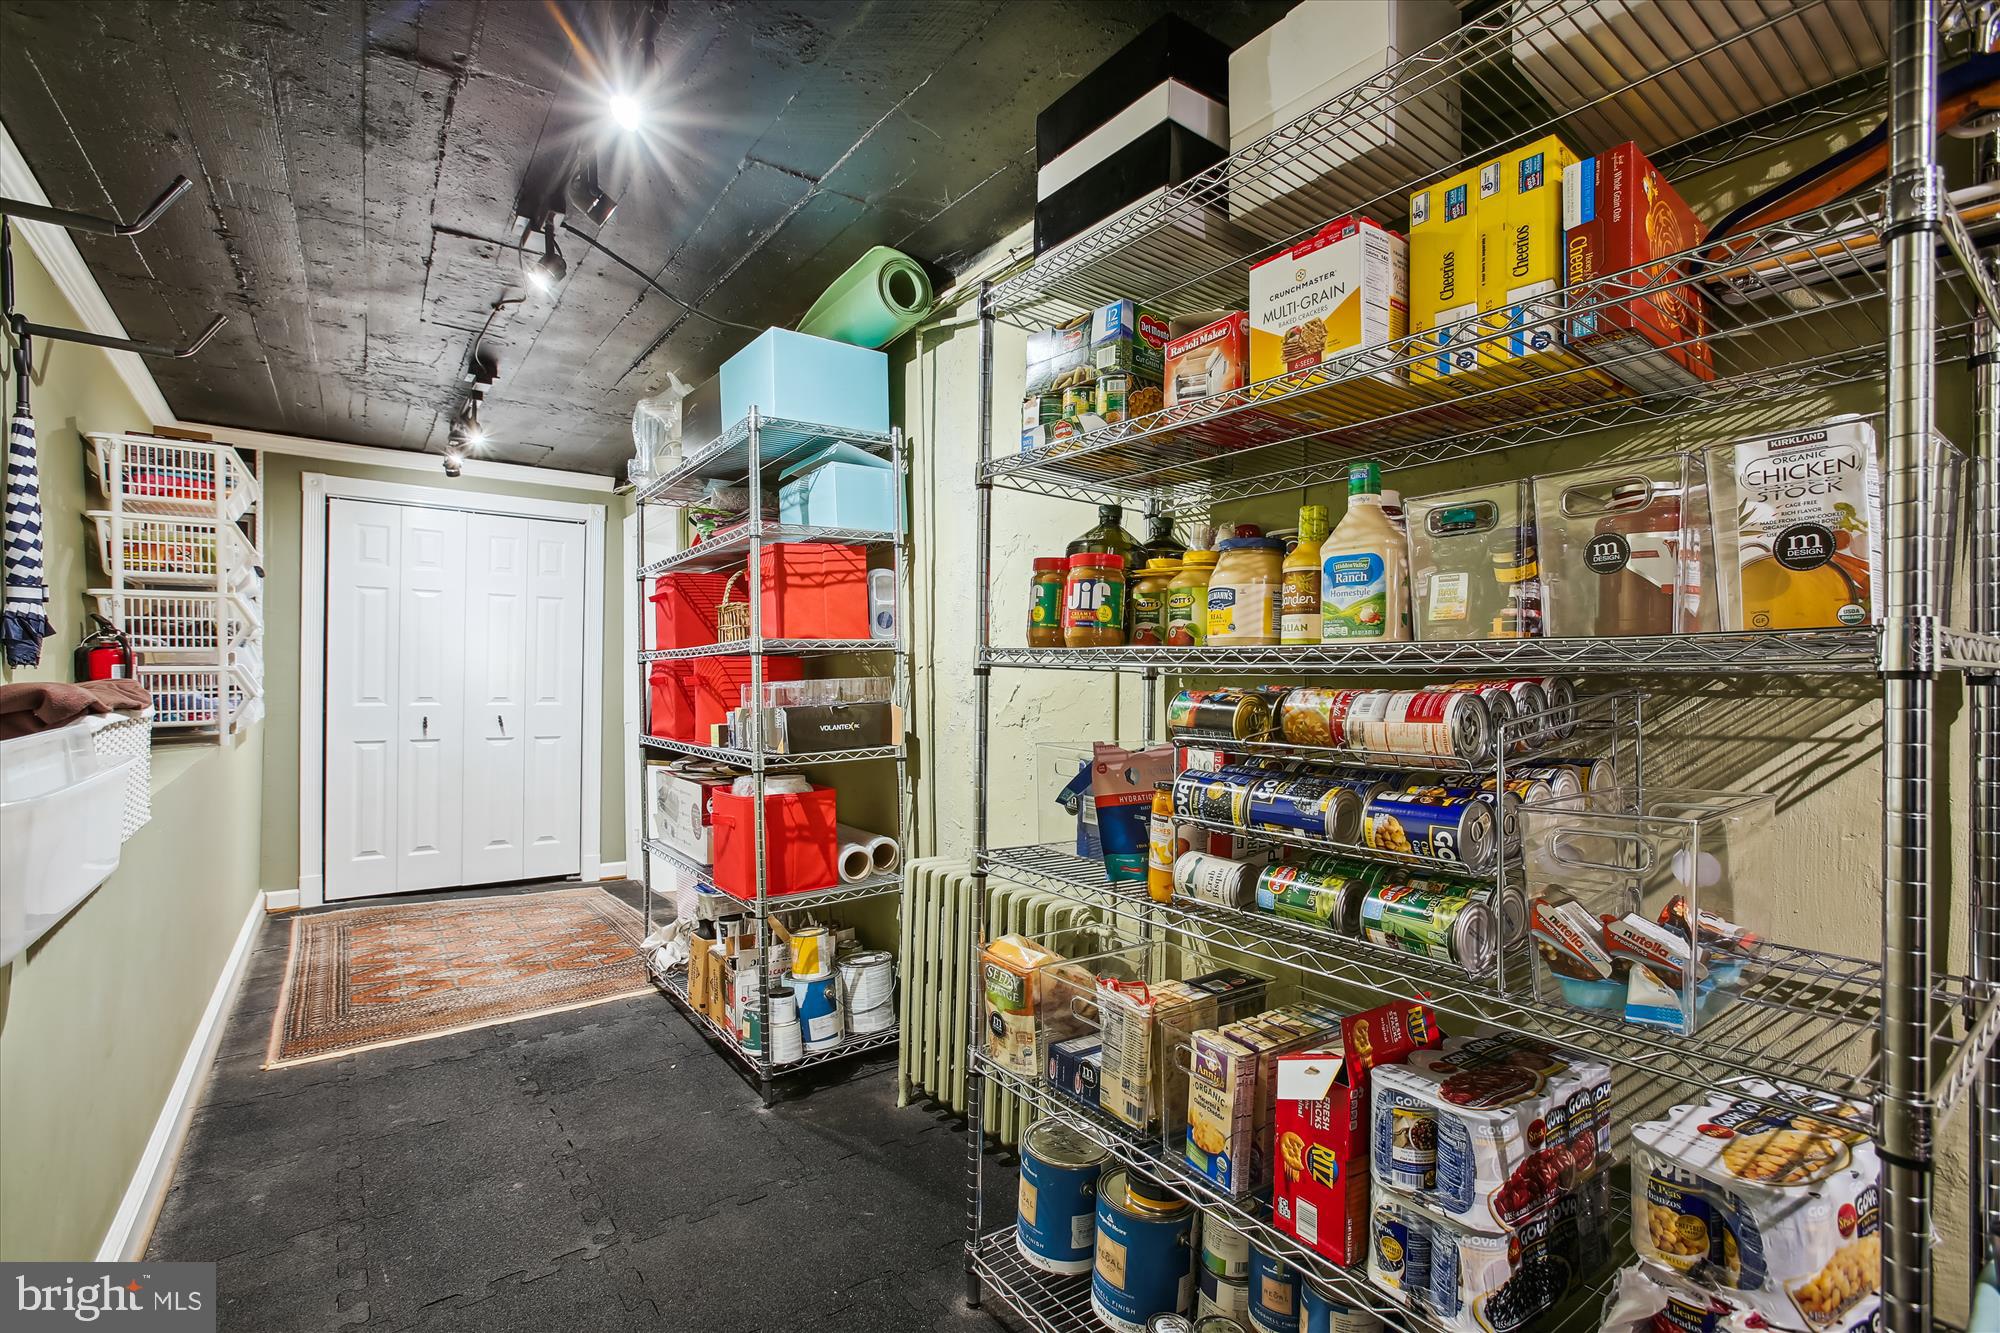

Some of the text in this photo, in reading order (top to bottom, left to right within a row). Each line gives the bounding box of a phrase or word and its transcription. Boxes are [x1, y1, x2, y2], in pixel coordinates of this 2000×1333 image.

[1512, 224, 1530, 278] Cheerios
[1584, 252, 1594, 273] Honey
[1269, 270, 1336, 302] CRUNCHMASTER
[1439, 251, 1455, 301] Cheerios
[1107, 308, 1118, 321] 12
[1262, 282, 1346, 325] MULTI-GRAIN
[1278, 304, 1329, 329] BAKED CRACKERS
[1140, 321, 1170, 340] Del Monte
[1170, 337, 1199, 358] Ravioli
[1199, 326, 1228, 345] Maker
[1294, 357, 1315, 370] 6-SEED
[1770, 432, 1825, 448] KIRKLAND
[1772, 450, 1827, 465] ORGANIC
[1747, 455, 1856, 486] CHICKEN
[1757, 480, 1843, 503] STOCK
[1797, 507, 1822, 515] FLAVOR
[1797, 511, 1845, 521] SLOW-COOKED
[1593, 541, 1620, 557] m
[1787, 547, 1824, 557] DESIGN
[1788, 533, 1823, 551] m
[1593, 553, 1620, 562] DESIGN
[1282, 582, 1297, 595] live
[1335, 572, 1368, 584] Ranch
[1067, 582, 1111, 610] Jif
[1330, 588, 1371, 599] Homestyle
[819, 722, 855, 732] VOLANTEX
[1119, 793, 1156, 803] HYDRATIO
[1176, 780, 1190, 817] OYA
[1205, 870, 1216, 893] Crab
[1212, 867, 1225, 899] Bisque
[1538, 917, 1565, 944] Breadsticks
[1548, 915, 1585, 950] nutella
[1613, 934, 1648, 957] Breadsticks
[1622, 929, 1669, 958] nutella
[1388, 1010, 1399, 1043] STACKS
[1392, 1011, 1402, 1040] FRESH
[1407, 1005, 1429, 1045] RITZ
[1194, 1081, 1226, 1107] ORGANIC
[1197, 1094, 1217, 1110] Macaroni
[1395, 1095, 1428, 1108] GOYA
[1568, 1090, 1591, 1115] GOYA
[1206, 1105, 1225, 1121] Cheddar
[1314, 1099, 1322, 1130] ACKS
[1322, 1096, 1331, 1131] FRESH
[1546, 1108, 1566, 1131] GOYA
[1477, 1125, 1510, 1136] GOYA
[1311, 1141, 1336, 1190] RITZ
[1647, 1191, 1682, 1210] banzos
[1658, 1185, 1682, 1200] Peas
[1856, 1188, 1878, 1215] GOYA
[1111, 1300, 1136, 1315] FINISH
[1672, 1304, 1702, 1324] Beans
[1662, 1310, 1702, 1333] olorados
